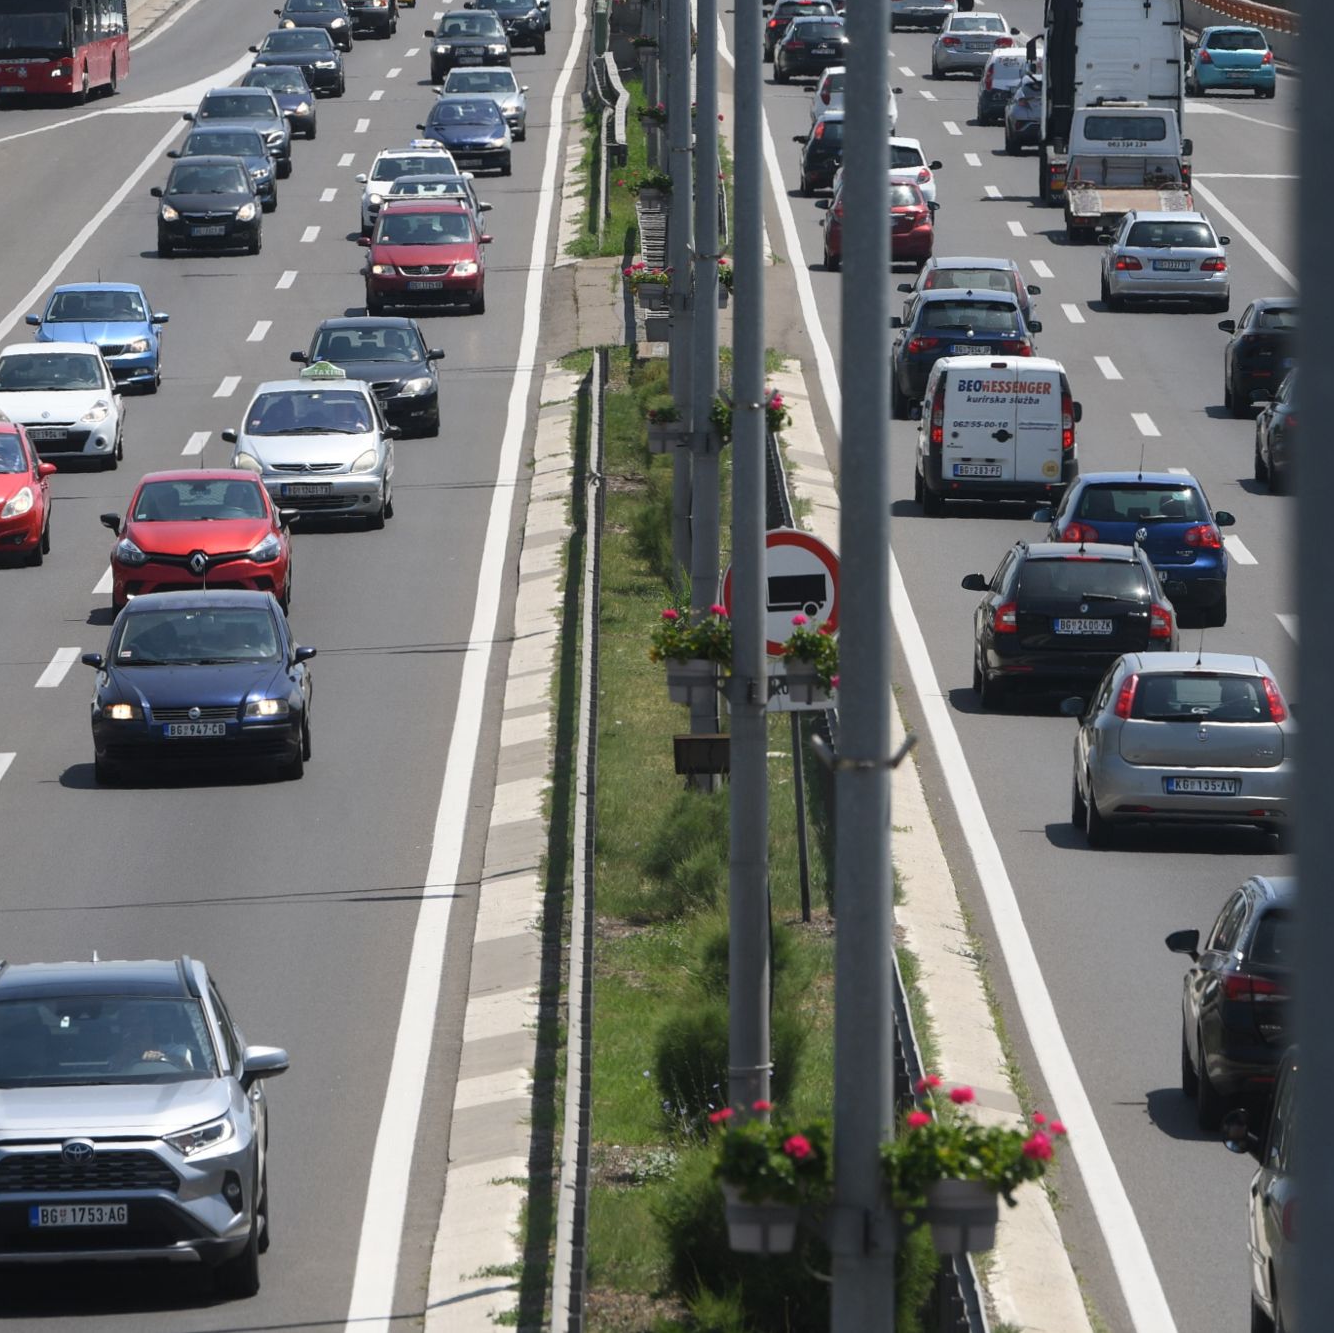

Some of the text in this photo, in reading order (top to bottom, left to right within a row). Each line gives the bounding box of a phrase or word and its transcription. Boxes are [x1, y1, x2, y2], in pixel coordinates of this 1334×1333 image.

[958, 379, 1052, 395] BEOMESSENGER
[966, 395, 1040, 405] kurirska služba
[1060, 620, 1071, 630] BG
[170, 725, 181, 735] BG
[1175, 778, 1189, 790] KG
[41, 1208, 58, 1224] BG
